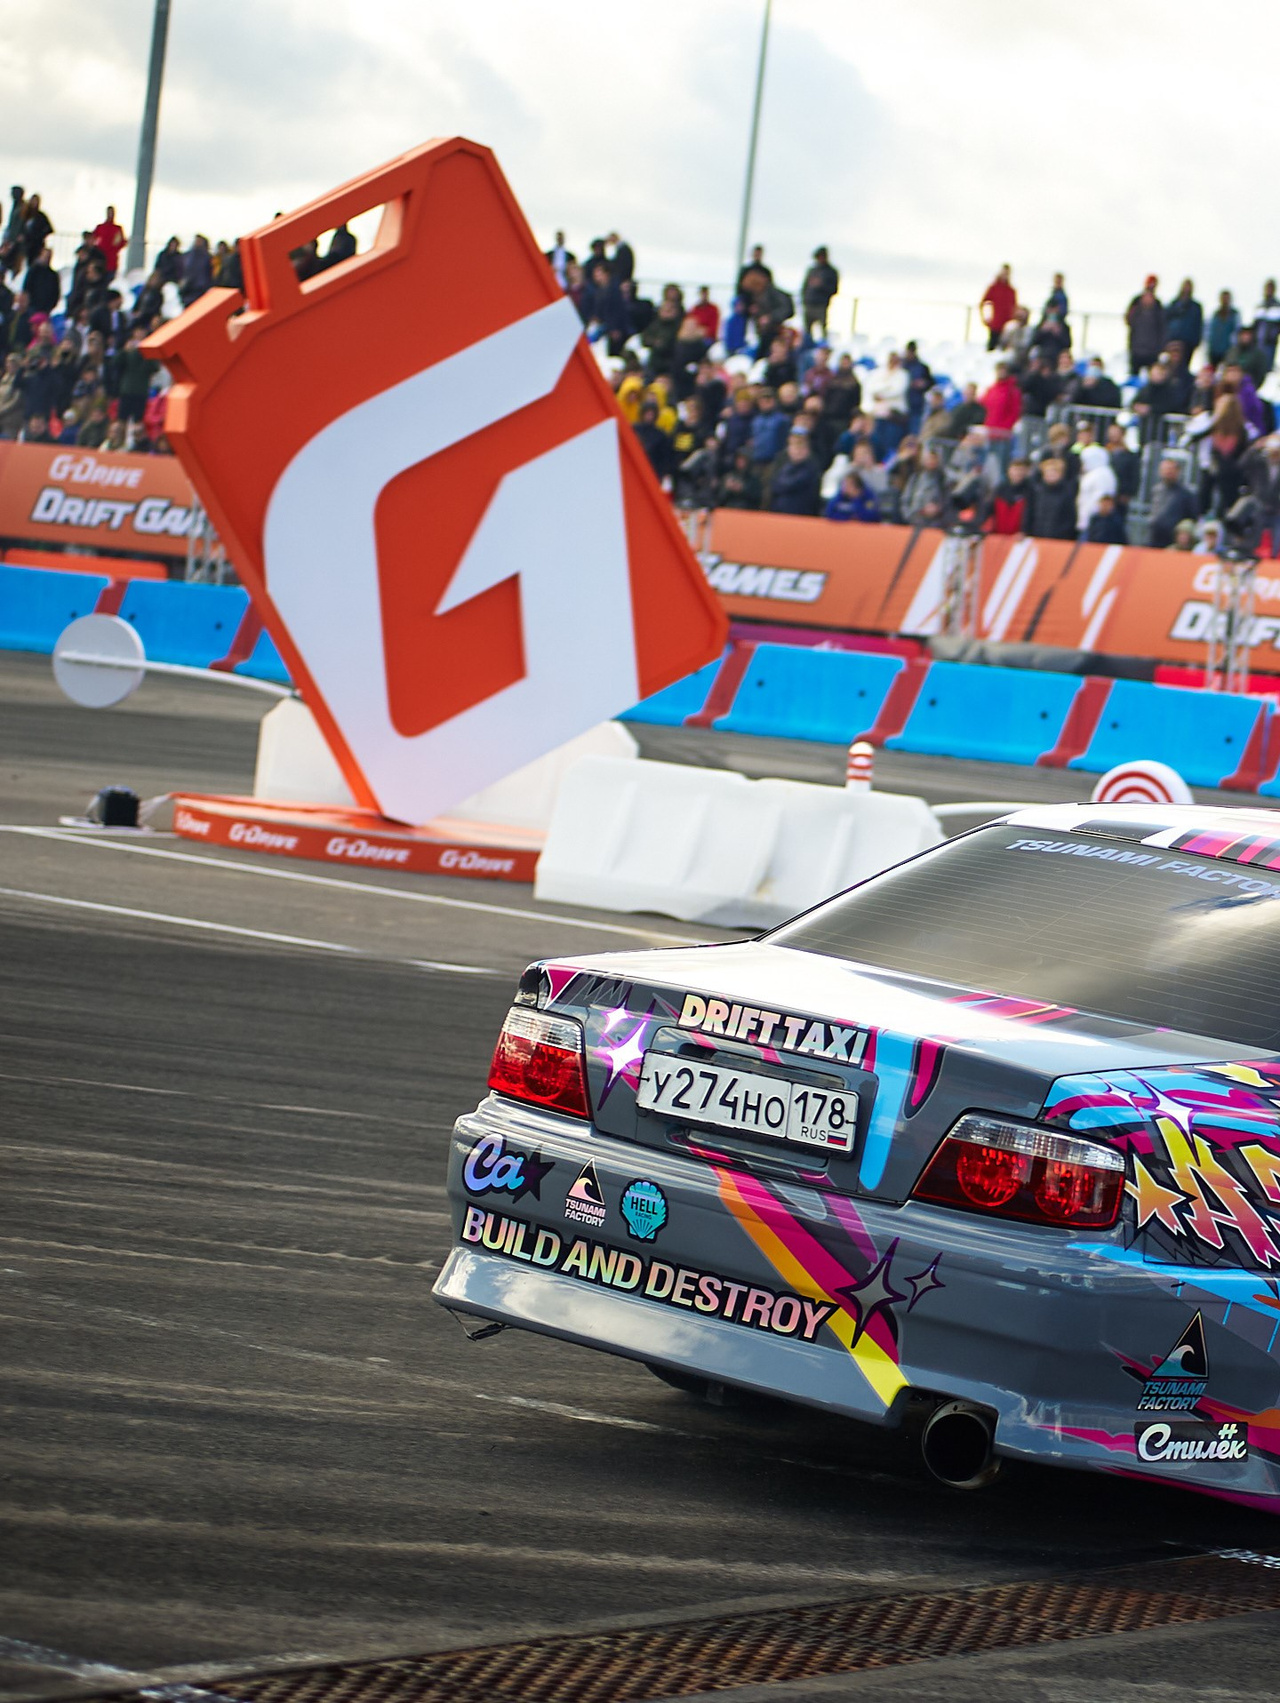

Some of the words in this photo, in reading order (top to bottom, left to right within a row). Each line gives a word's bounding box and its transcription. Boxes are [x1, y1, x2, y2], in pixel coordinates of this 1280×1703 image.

[31, 486, 136, 530] DRIFT
[696, 552, 829, 603] AMES
[1005, 838, 1159, 867] TSUNAMI
[677, 993, 780, 1045] DRIFT
[783, 1016, 869, 1064] TAXI
[793, 1091, 846, 1129] 178
[801, 1126, 827, 1141] RUS
[565, 1198, 607, 1218] TSUNAMI
[631, 1196, 657, 1215] HELL
[564, 1208, 605, 1228] FACTORY
[462, 1205, 560, 1268] BUILD
[562, 1240, 643, 1290] AND
[644, 1262, 834, 1339] DESTROY
[1142, 1381, 1207, 1396] TSUNAMI
[1137, 1396, 1202, 1411] FACTORY
